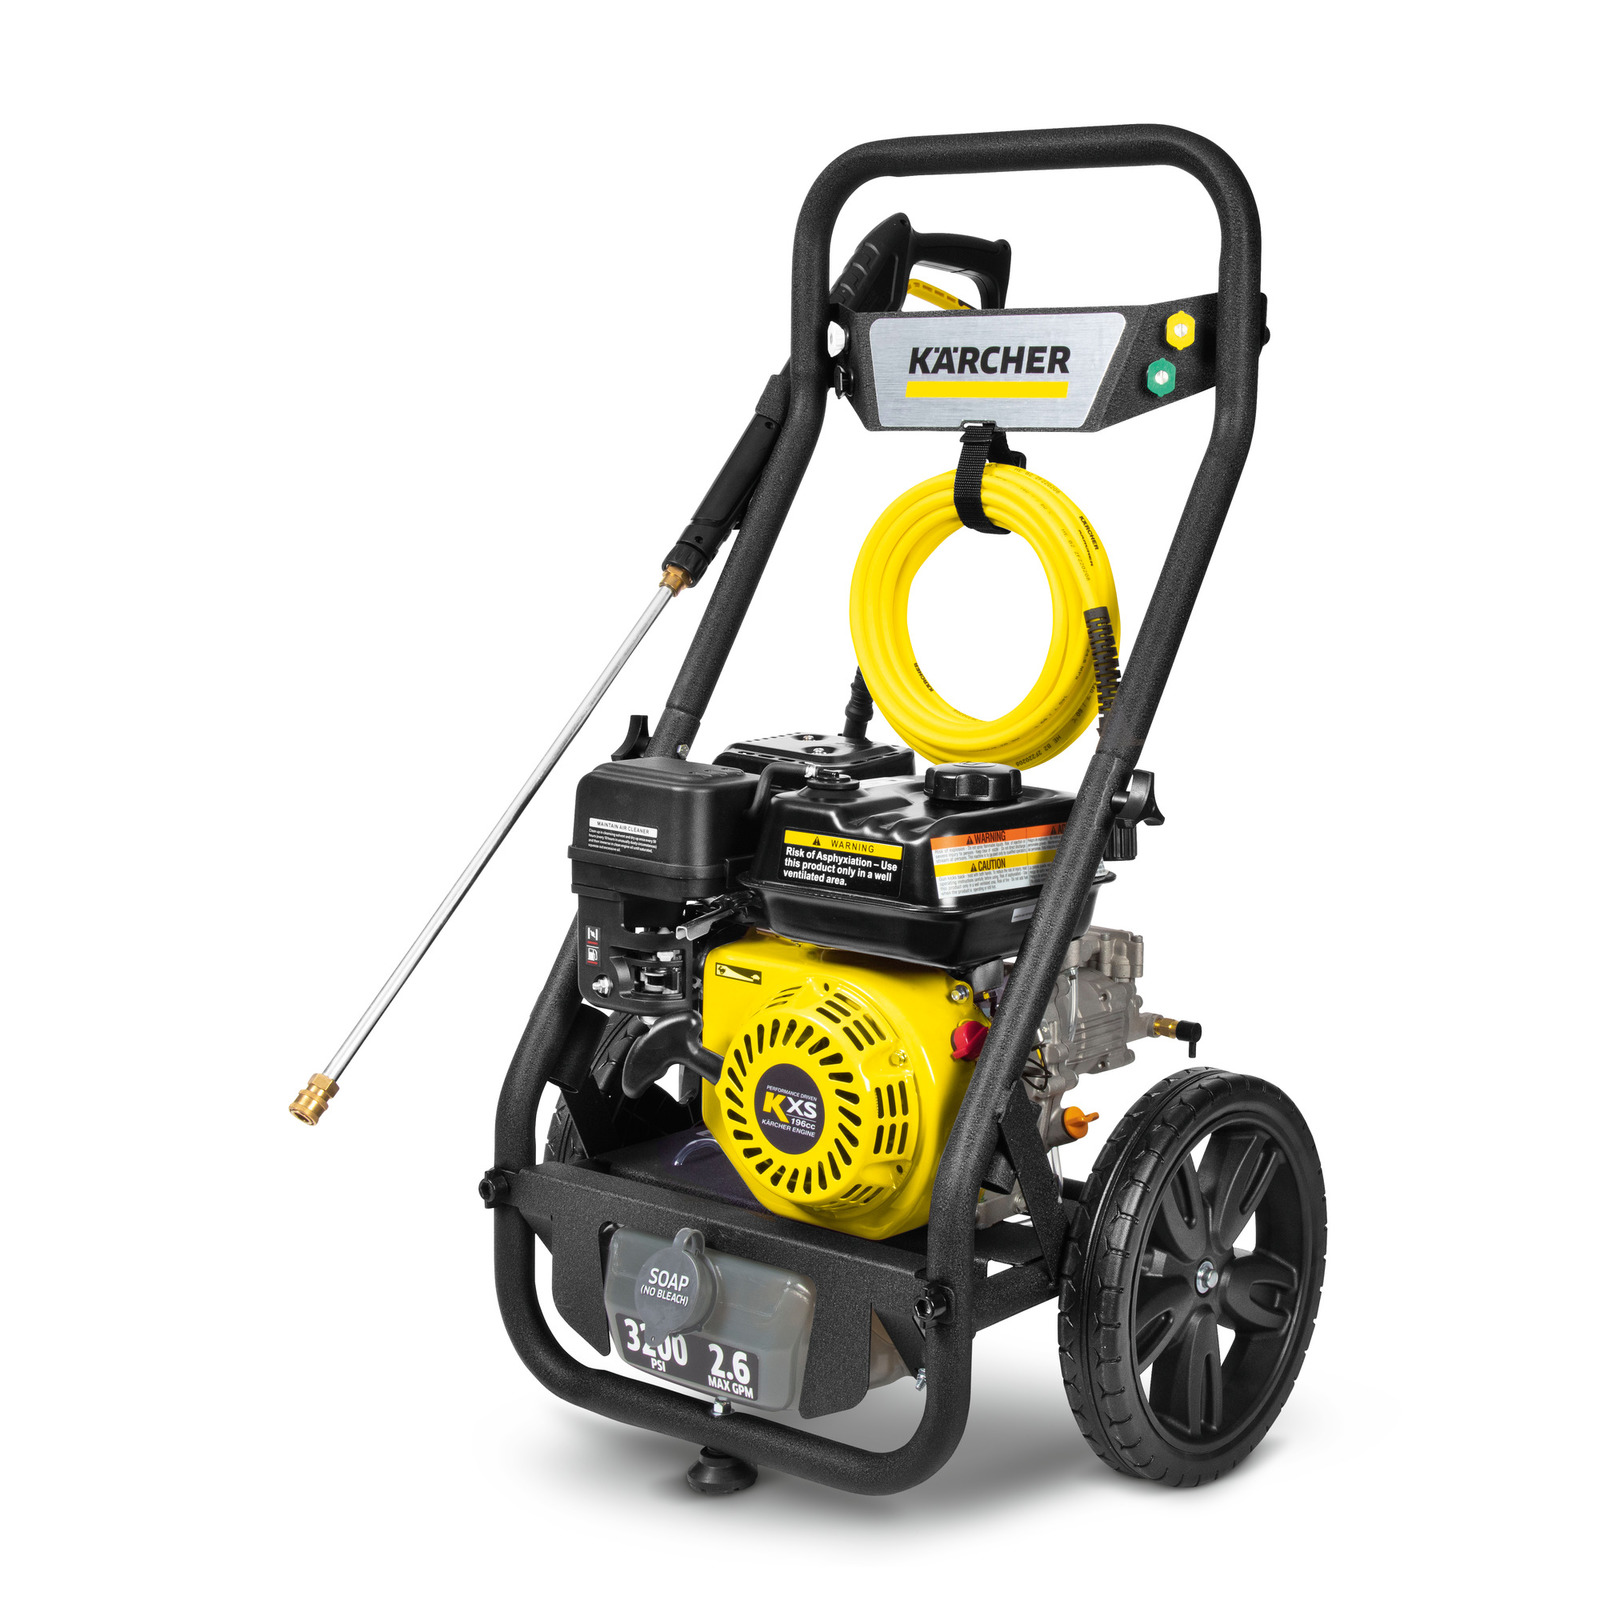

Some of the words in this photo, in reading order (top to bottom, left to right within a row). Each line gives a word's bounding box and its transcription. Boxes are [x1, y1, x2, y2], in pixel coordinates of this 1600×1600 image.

[908, 346, 1071, 374] KÄRCHER
[831, 840, 874, 853] WARNING
[974, 831, 1006, 844] WARNING
[786, 847, 805, 858] Risk
[806, 850, 816, 859] of
[816, 851, 872, 868] Asphyxiation
[881, 861, 898, 872] Use
[978, 858, 1006, 871] CAUTION
[783, 869, 825, 883] ventilated
[826, 876, 847, 886] area.
[784, 858, 800, 868] this
[802, 861, 835, 874] product
[837, 866, 856, 878] only
[857, 868, 866, 878] in
[874, 872, 892, 882] well
[766, 1085, 800, 1097] PERFORMANCE
[800, 1093, 817, 1101] DRIVEN
[762, 1119, 791, 1131] KÄRCHER
[792, 1126, 816, 1137] ENGINE
[791, 1118, 816, 1130] 196cc
[648, 1267, 690, 1292] SOAP
[640, 1285, 656, 1297] (NO
[656, 1289, 689, 1306] BLEACH)
[651, 1358, 666, 1372] PSI
[709, 1343, 751, 1385] 2.6
[707, 1375, 730, 1393] MAX
[732, 1383, 754, 1399] GPM
